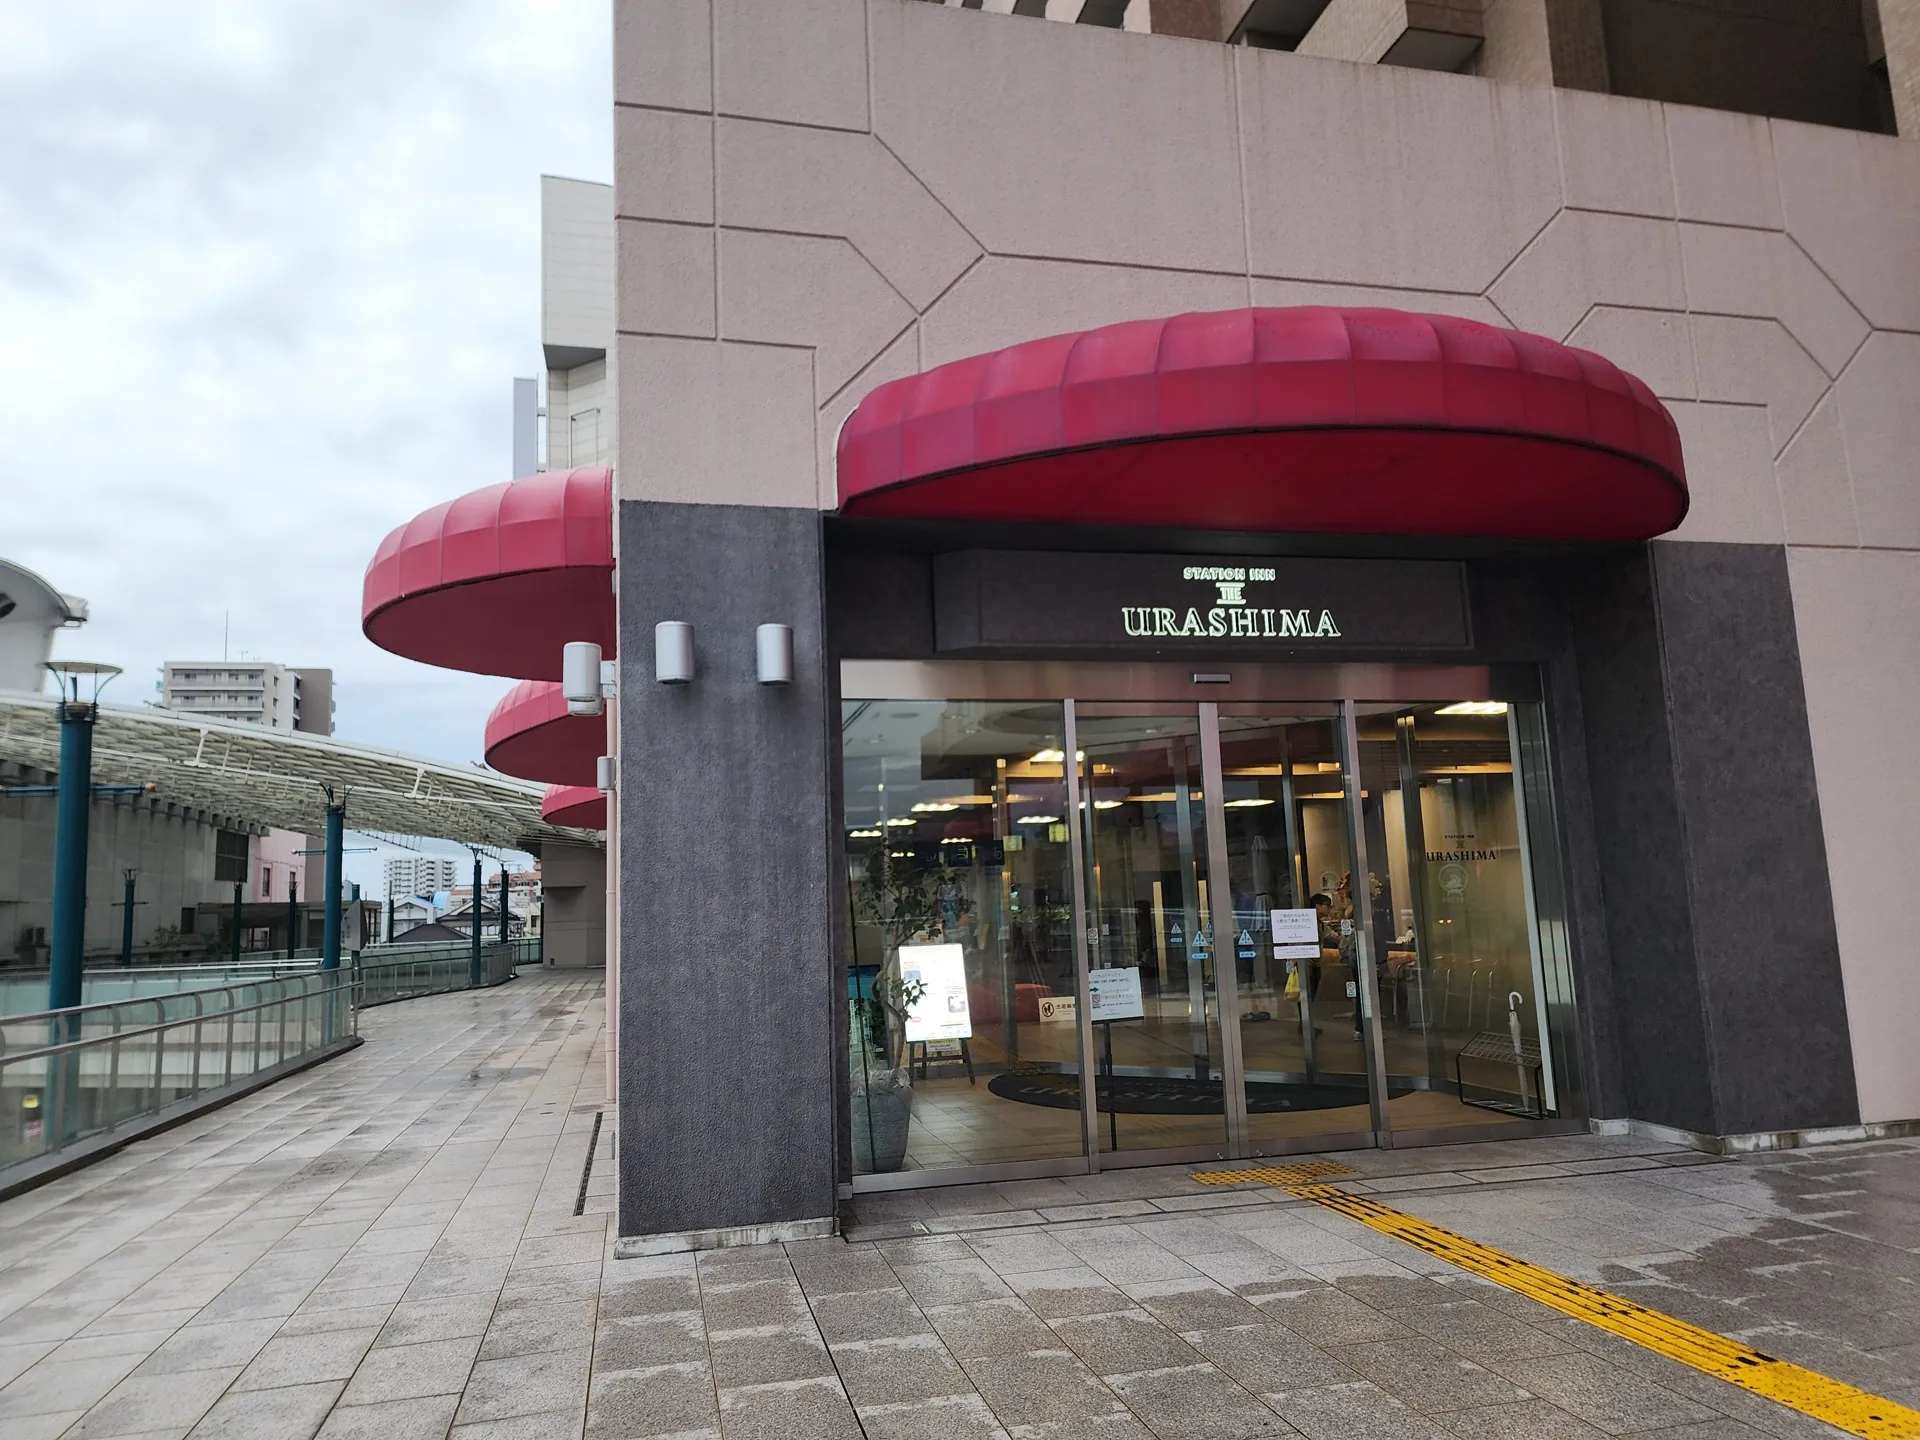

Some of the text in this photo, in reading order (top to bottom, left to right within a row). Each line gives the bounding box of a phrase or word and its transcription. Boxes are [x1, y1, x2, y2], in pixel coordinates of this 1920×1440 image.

[1183, 567, 1276, 581] STATION INN
[1217, 584, 1244, 602] THE
[1121, 607, 1341, 637] URASHIMA
[1426, 850, 1497, 862] URASHIMA
